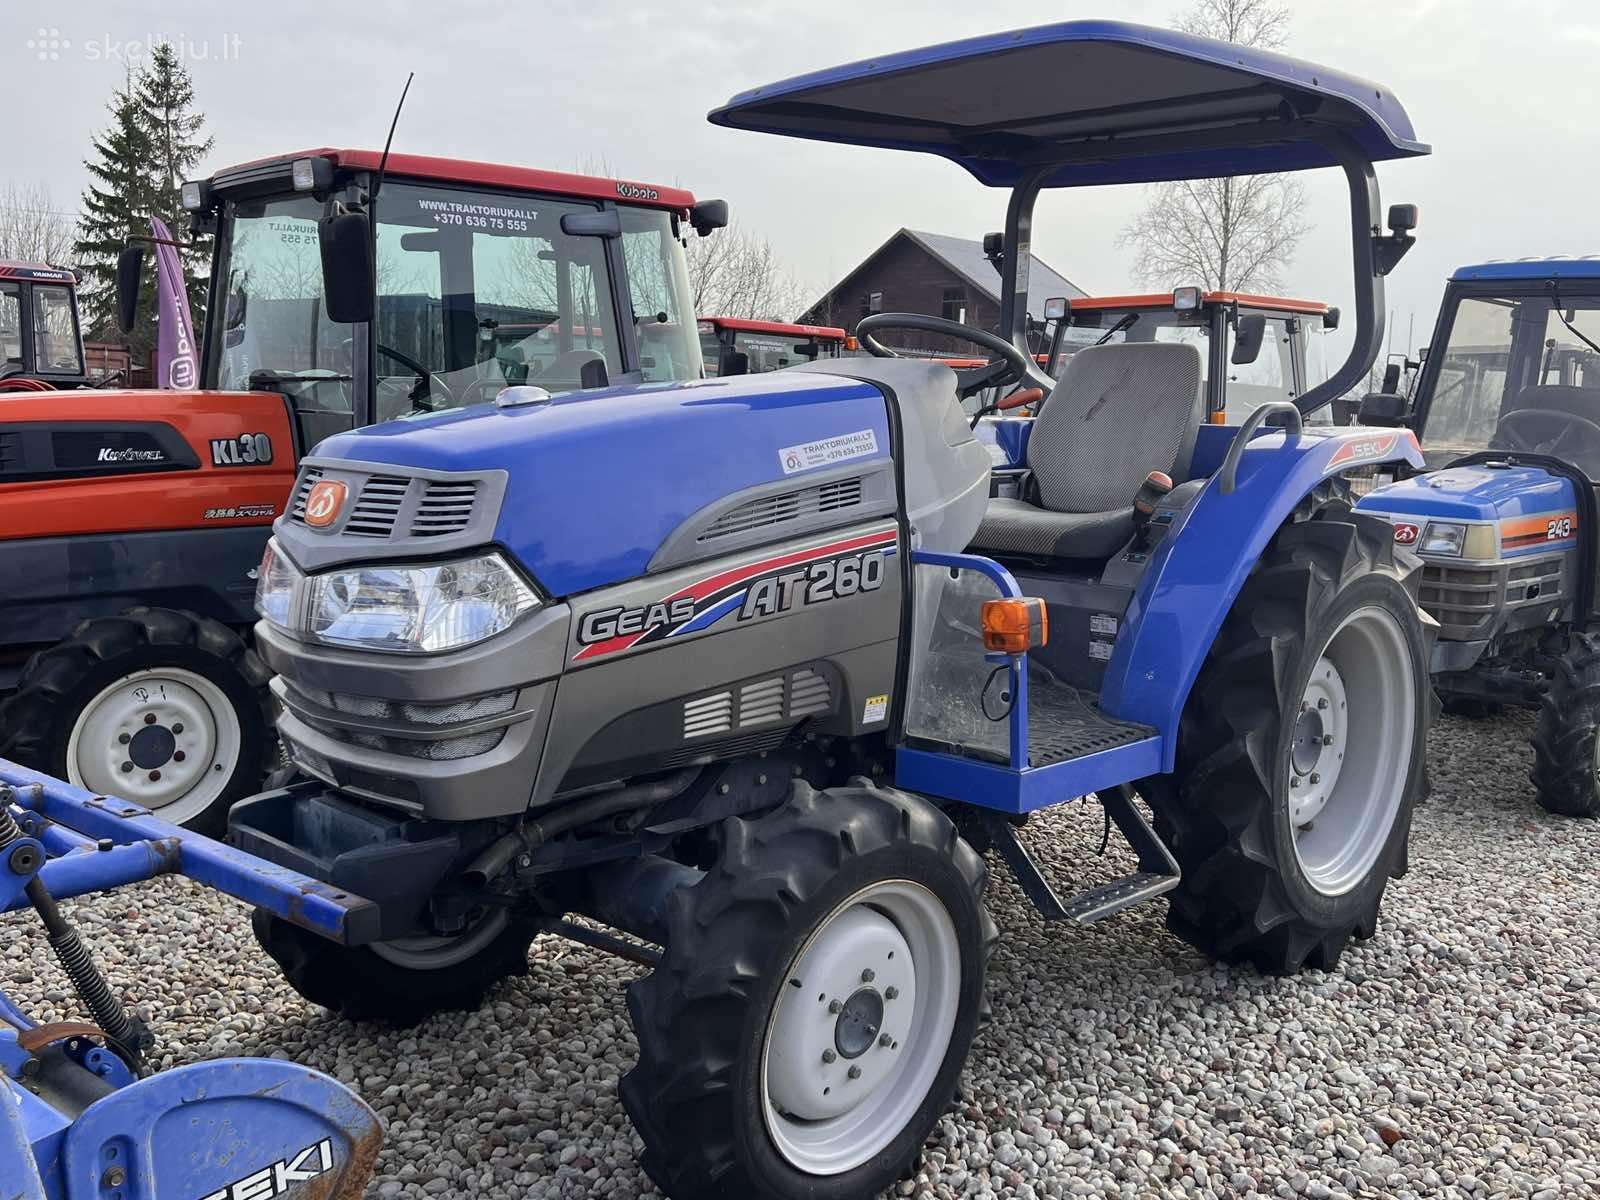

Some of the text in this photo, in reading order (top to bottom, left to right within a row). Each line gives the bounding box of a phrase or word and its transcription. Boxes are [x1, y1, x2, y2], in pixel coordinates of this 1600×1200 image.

[616, 182, 659, 200] Kubota
[418, 199, 539, 220] WWW.TRAKTORIUKAI.LT
[433, 212, 528, 231] +370 636 75 555
[32, 271, 63, 279] YANMAR
[210, 432, 273, 467] KL30
[802, 432, 873, 454] TRAKTORIUKAI.LT
[1351, 441, 1383, 457] ISEKI
[1547, 518, 1571, 540] 243
[736, 551, 885, 622] AT260
[199, 1136, 334, 1200] EKI
